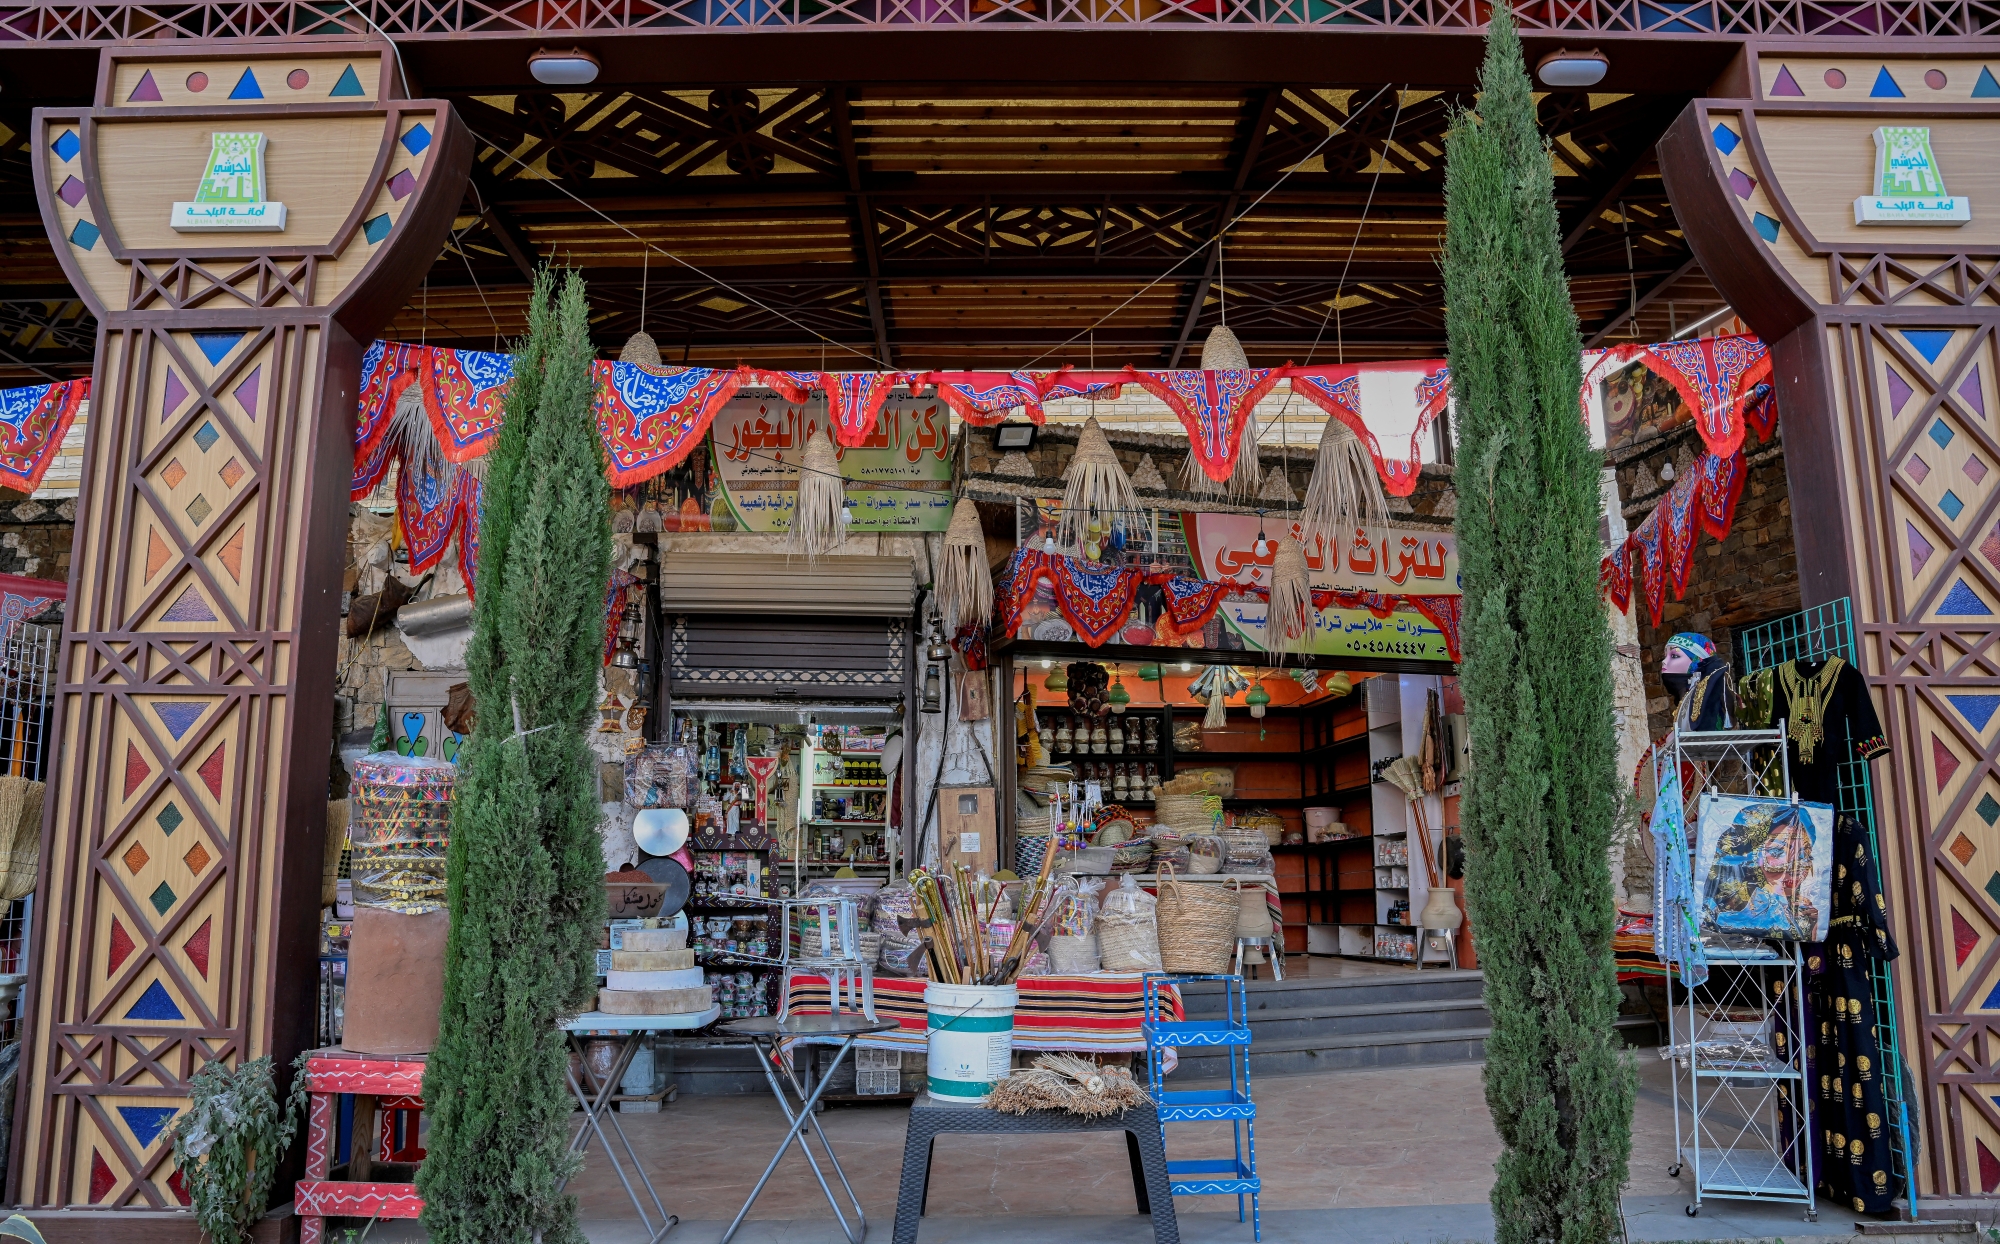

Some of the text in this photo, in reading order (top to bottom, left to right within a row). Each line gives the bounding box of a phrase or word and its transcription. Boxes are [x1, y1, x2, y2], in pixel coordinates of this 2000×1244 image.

[213, 157, 251, 176] بلجرشي
[1891, 151, 1929, 170] بلجرشي
[905, 404, 950, 463] ركن
[740, 494, 767, 511] وشعبية
[768, 493, 794, 511] تراثية
[866, 495, 897, 511] بخورات
[1348, 527, 1447, 585] للتراث
[1344, 617, 1382, 635] ملابس
[1346, 639, 1426, 655] ٠٥٠٤٥٨٤٤٤٧
